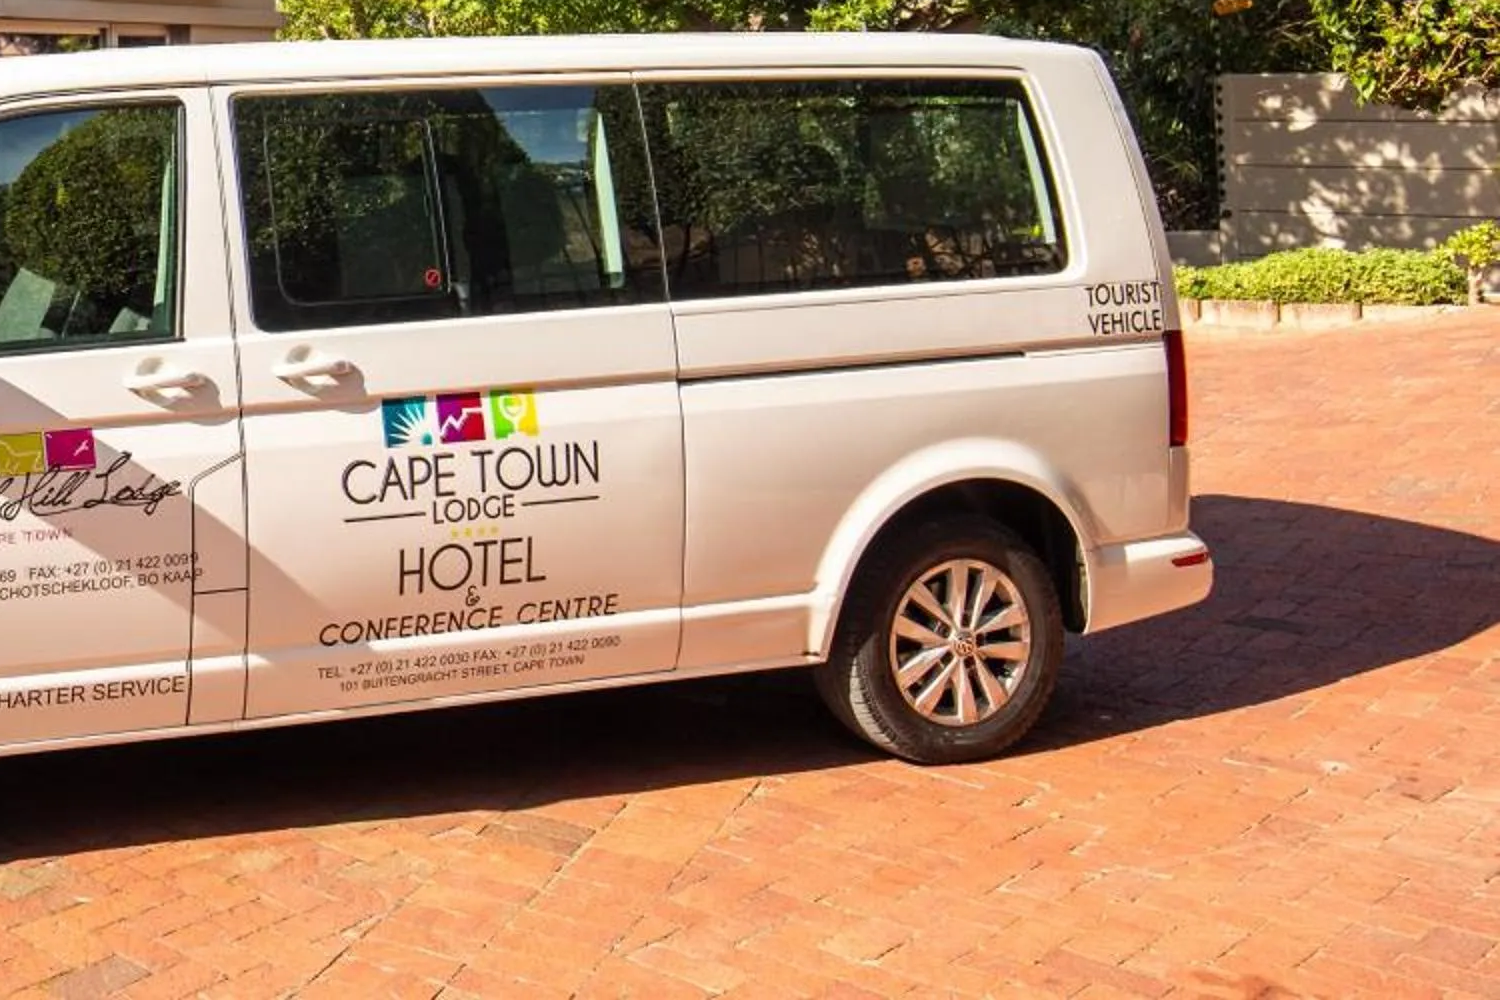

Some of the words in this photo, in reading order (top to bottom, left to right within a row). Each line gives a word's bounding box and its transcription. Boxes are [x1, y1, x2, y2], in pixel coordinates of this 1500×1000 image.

[1085, 282, 1160, 307] TOURIST
[1088, 309, 1161, 335] VEHICLE
[0, 463, 91, 520] Hill
[84, 451, 183, 515] Lodge
[341, 453, 455, 505] CAPE
[470, 440, 600, 493] TOWN
[433, 494, 515, 524] LODGE
[25, 527, 73, 543] TOWN
[65, 562, 89, 576] +27
[93, 560, 113, 575] (0)
[116, 559, 131, 571] 21
[136, 556, 160, 569] 422
[138, 573, 159, 587] BO
[164, 568, 203, 583] KAAP
[399, 536, 546, 596] HOTEL
[465, 585, 480, 606] &
[319, 606, 503, 646] CONFERENCE
[516, 593, 619, 624] CENTRE
[396, 659, 409, 670] 21
[413, 655, 436, 668] 422
[567, 639, 588, 651] 422
[514, 660, 545, 673] CAPE
[550, 654, 585, 668] TOWN
[92, 675, 186, 701] SERVICE
